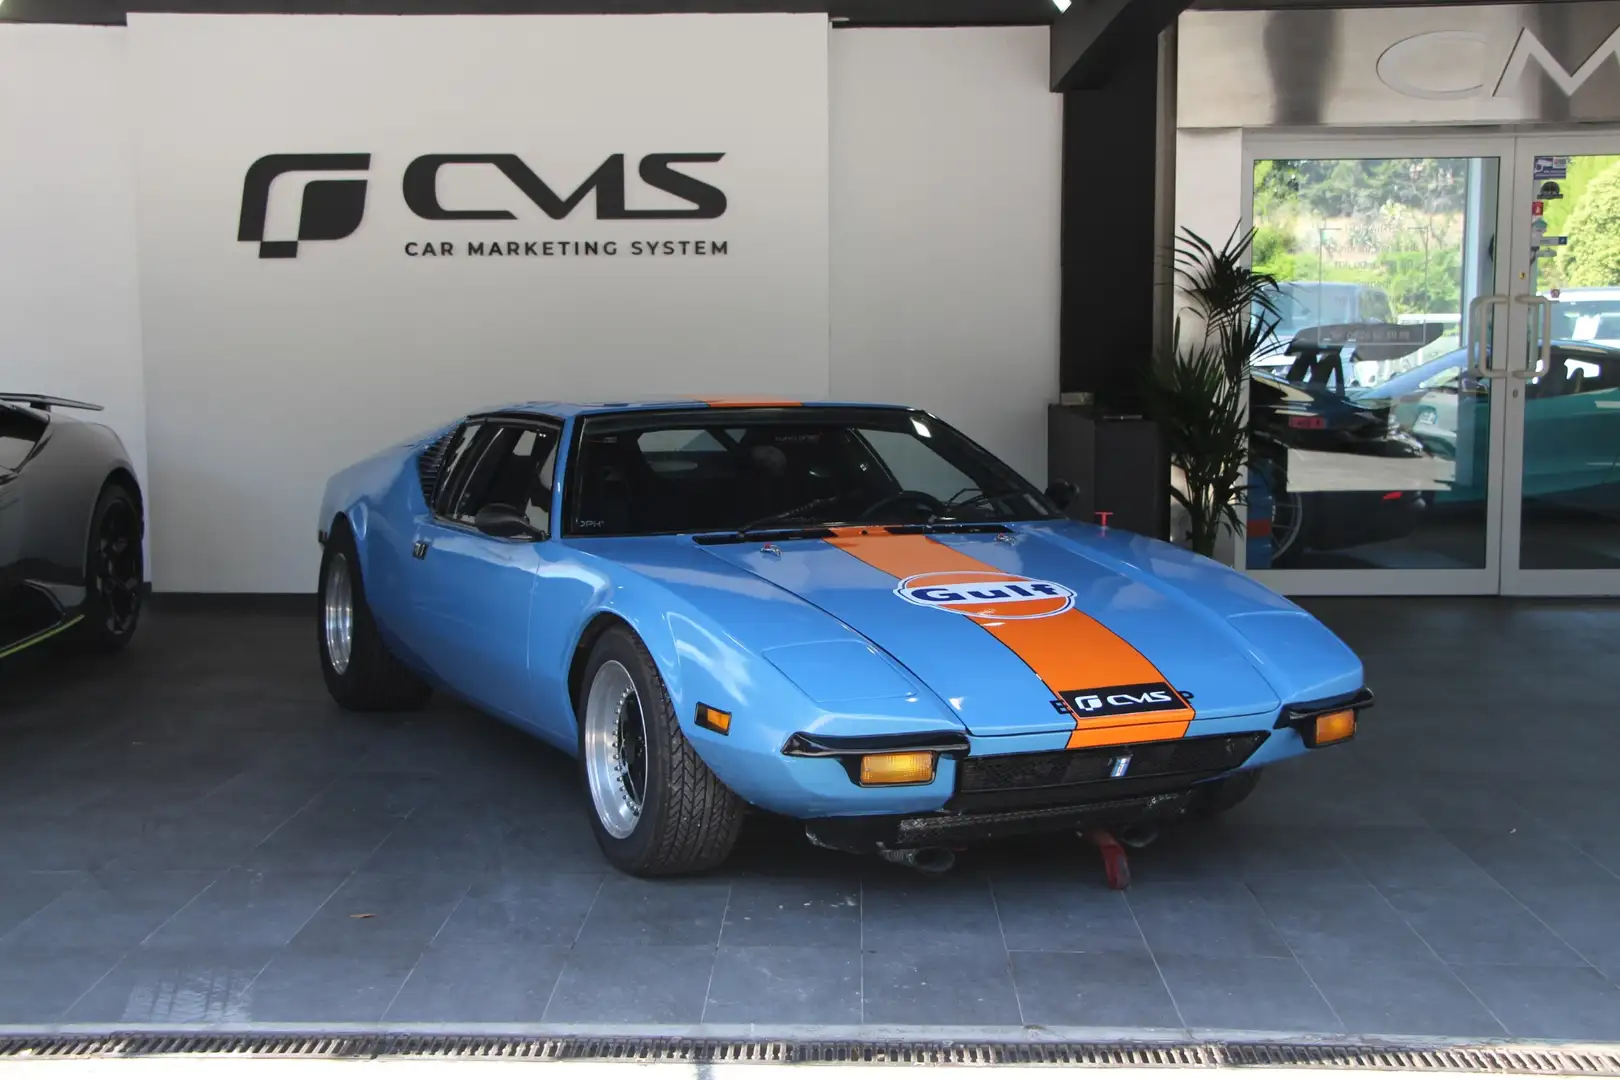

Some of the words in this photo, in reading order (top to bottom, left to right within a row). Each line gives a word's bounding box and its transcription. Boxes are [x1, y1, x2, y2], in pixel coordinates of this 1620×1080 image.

[402, 153, 727, 220] CMS
[404, 241, 454, 257] CAR
[467, 240, 618, 257] MARKETING
[630, 240, 730, 256] SYSTEM
[910, 583, 1059, 602] Gulf
[1106, 691, 1172, 706] CMS
